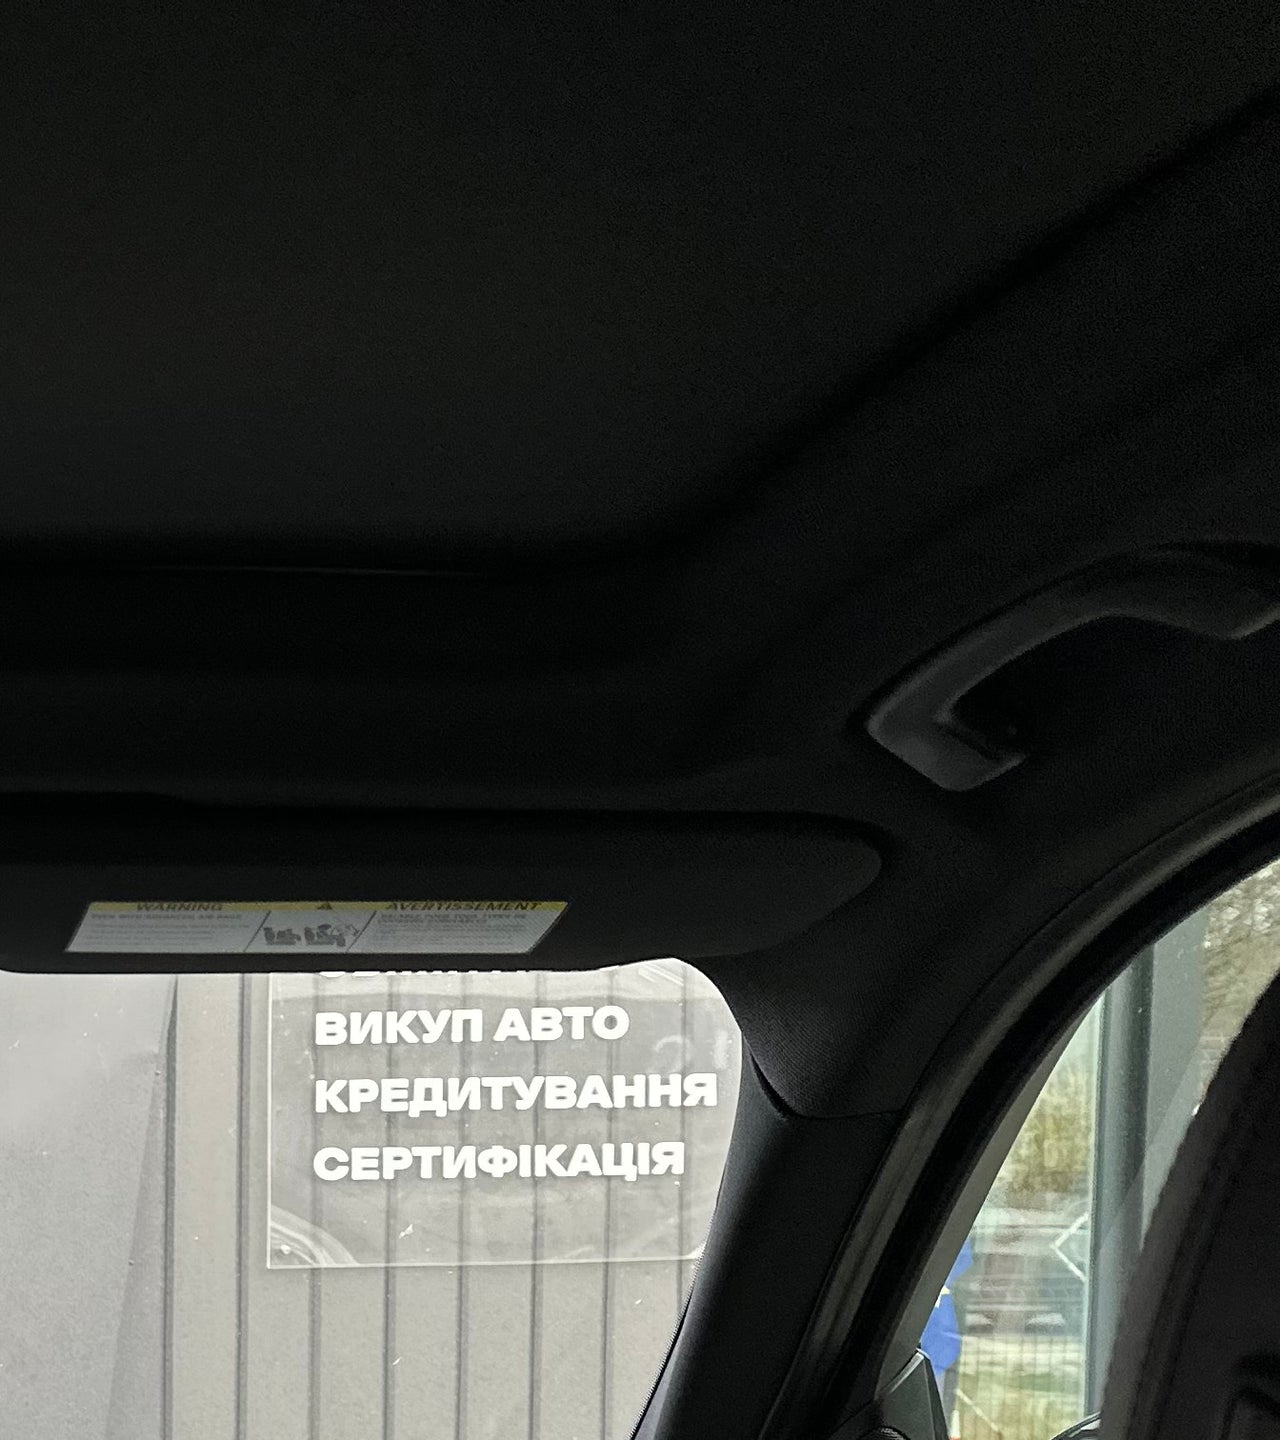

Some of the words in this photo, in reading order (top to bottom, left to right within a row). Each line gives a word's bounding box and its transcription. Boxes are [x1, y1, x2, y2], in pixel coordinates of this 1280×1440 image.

[136, 902, 223, 912] WARNING
[386, 902, 542, 912] AVERTISSEMENT
[314, 1008, 483, 1046] ВИКУП
[493, 1005, 630, 1042] АВТО
[315, 1072, 718, 1118] КРЕДИТУВАННЯ
[313, 1141, 685, 1182] СЕРТИФІКАЦІЯ
